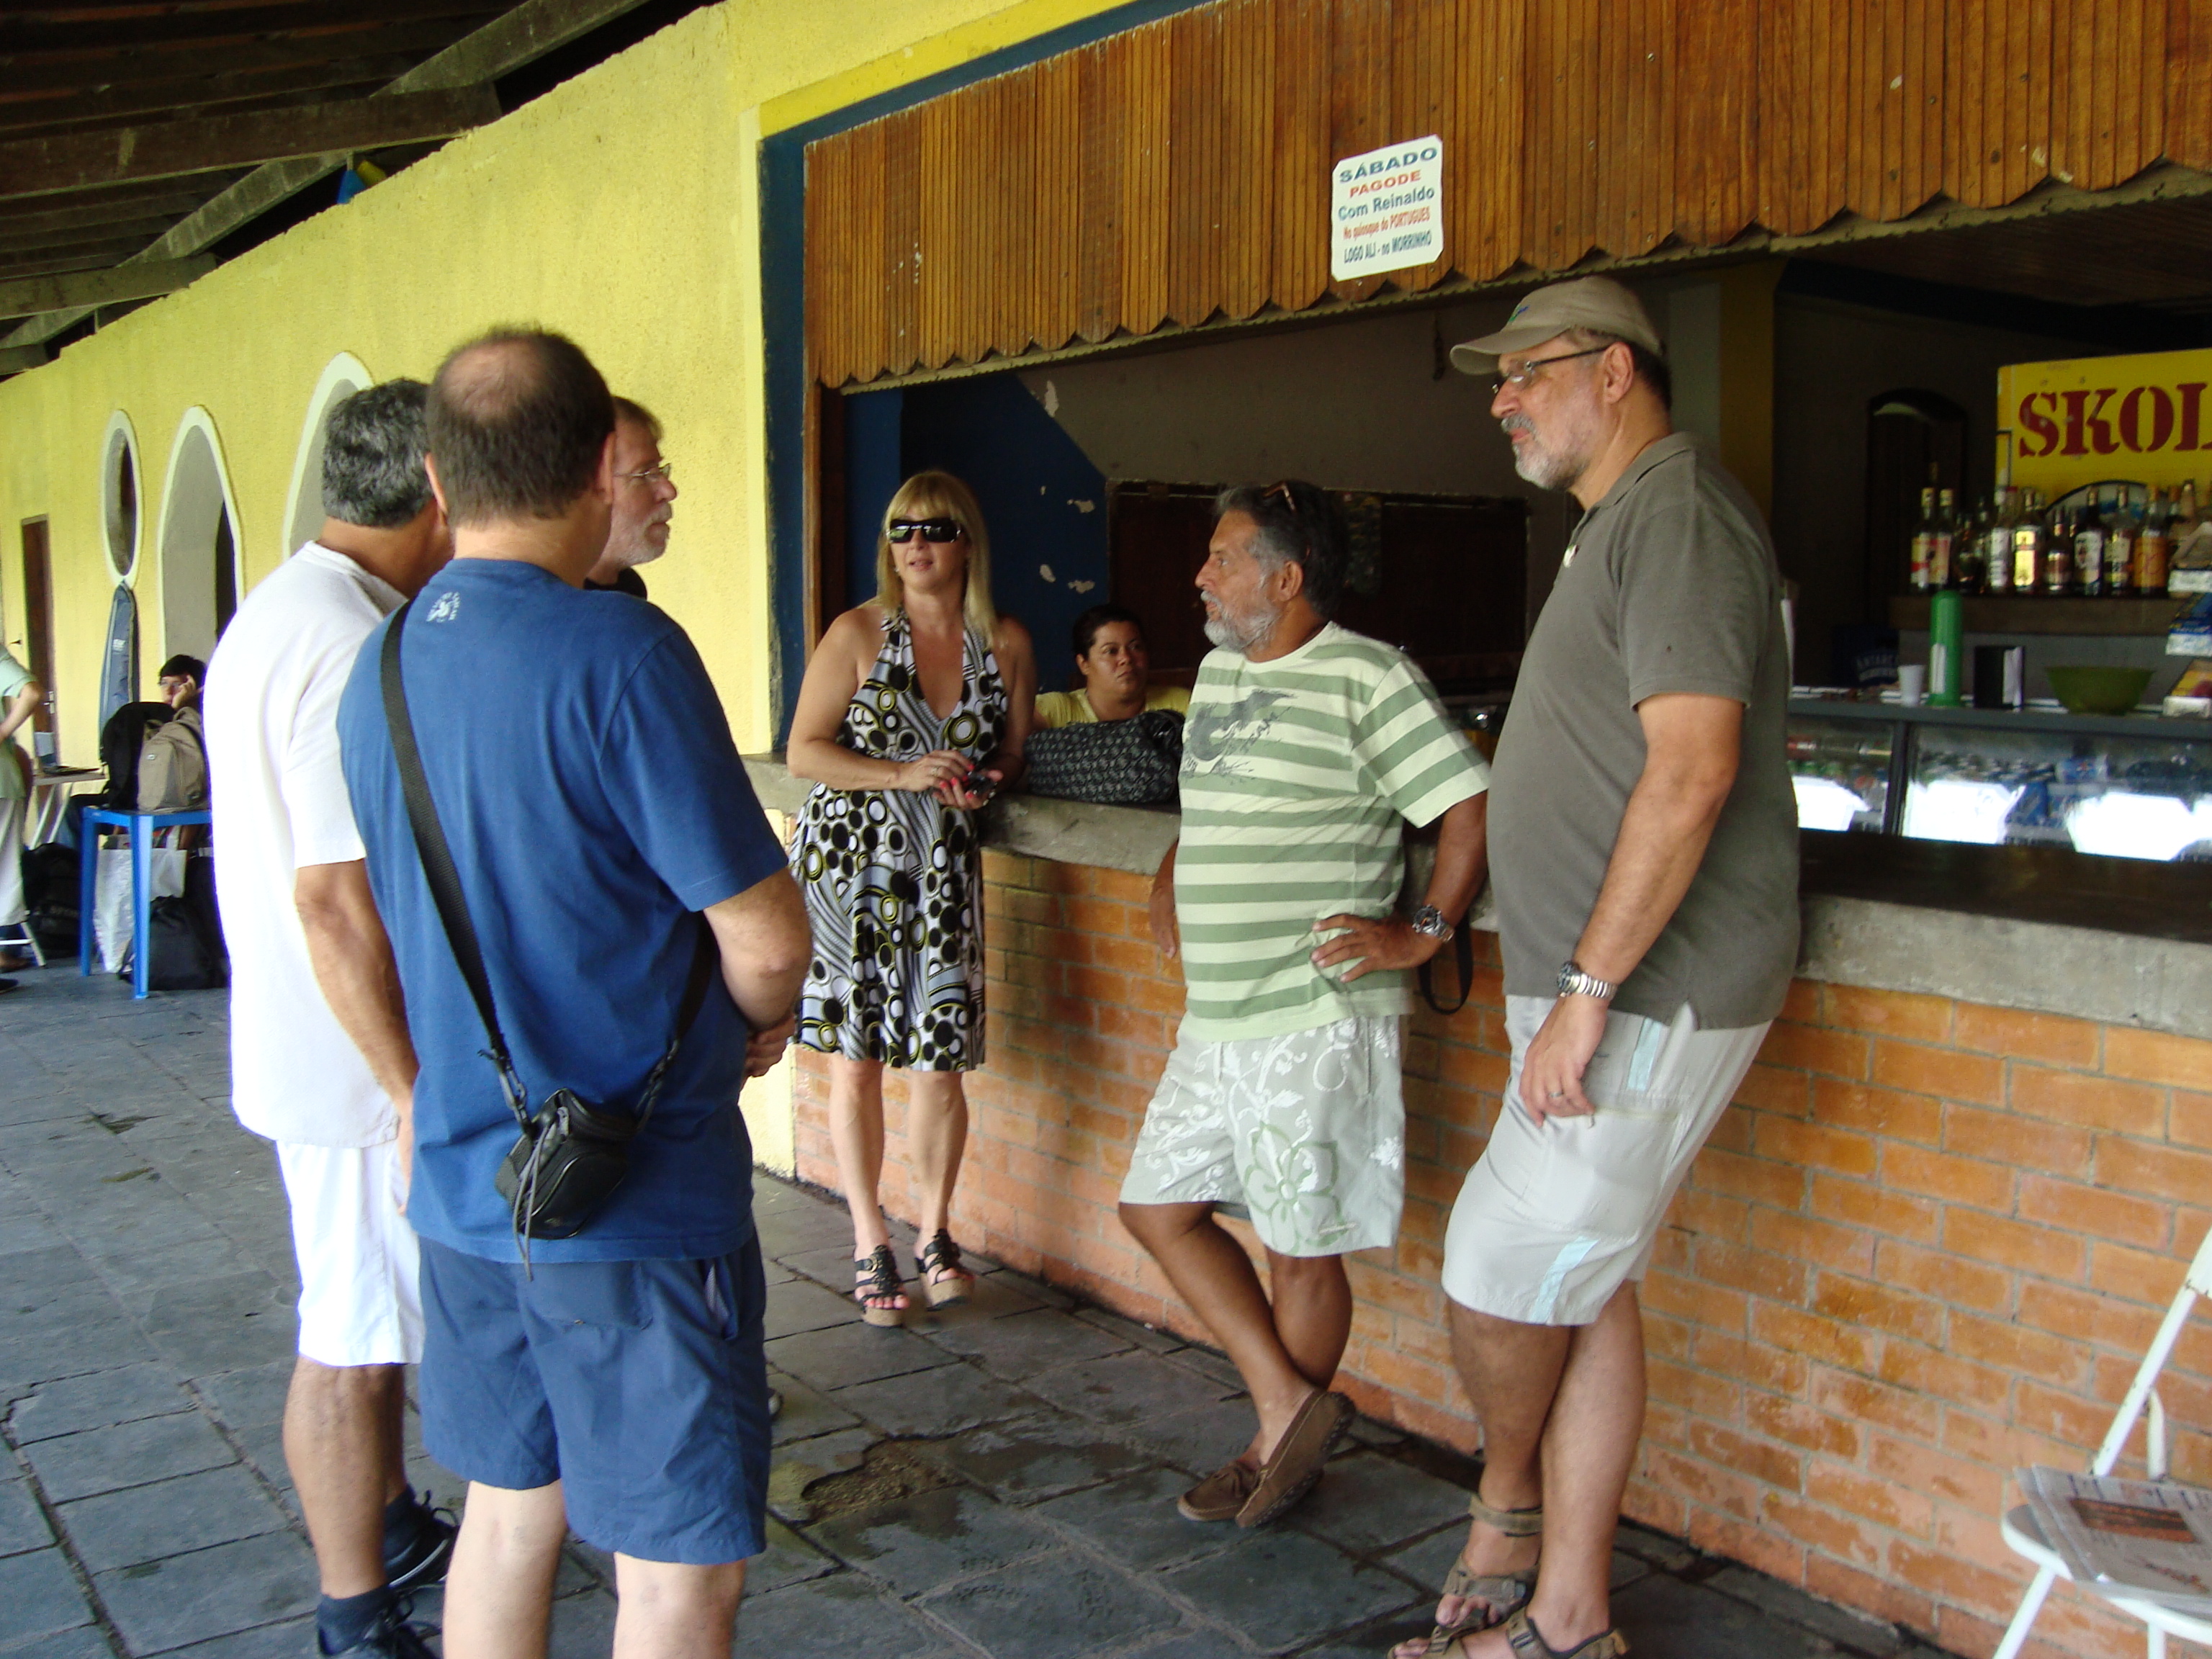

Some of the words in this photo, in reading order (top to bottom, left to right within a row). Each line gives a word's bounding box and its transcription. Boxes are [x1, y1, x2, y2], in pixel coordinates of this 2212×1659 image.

[1349, 170, 1421, 198] PAGODE
[1338, 205, 1369, 221] Com
[1373, 186, 1435, 213] Reinaldo
[1344, 245, 1363, 264] LOGO
[1381, 243, 1390, 256] no
[1391, 229, 1431, 252] MORRINHO
[2019, 382, 2212, 458] SKOL
